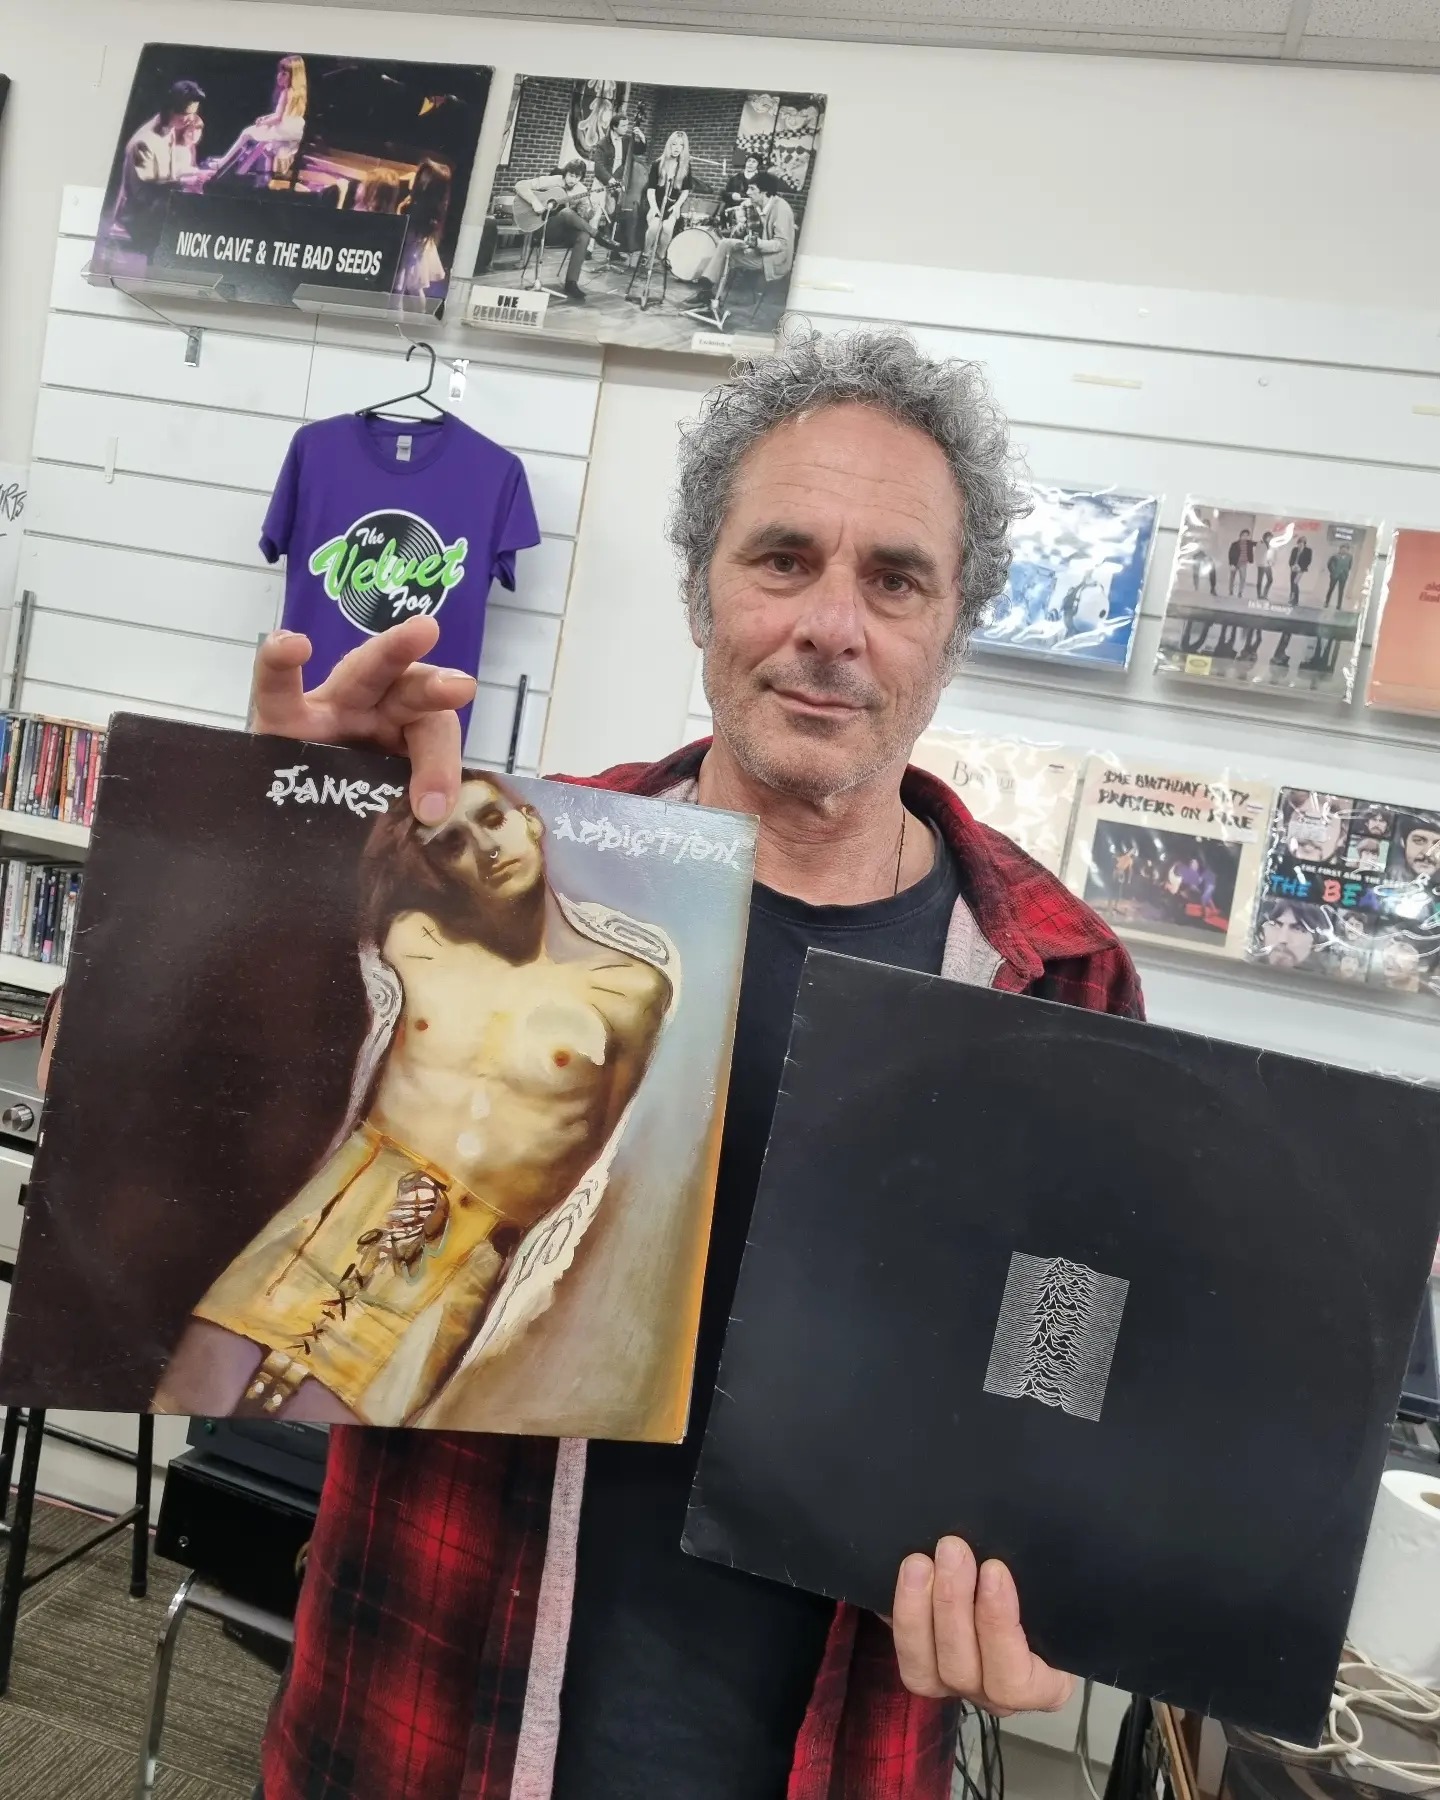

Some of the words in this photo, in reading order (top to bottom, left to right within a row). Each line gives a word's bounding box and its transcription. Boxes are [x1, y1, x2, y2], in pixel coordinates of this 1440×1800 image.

[176, 231, 211, 258] NICK
[213, 235, 253, 263] CAVE
[255, 240, 267, 264] &
[271, 241, 300, 268] THE
[301, 244, 333, 271] BAD
[335, 247, 382, 276] SEEDS
[0, 483, 28, 521] RTS
[355, 527, 385, 547] The
[311, 537, 467, 598] Velvet
[388, 586, 432, 617] Fog
[1098, 788, 1175, 816] PRAYERS
[1181, 806, 1201, 820] ON
[1135, 774, 1203, 797] BIRTHDAY
[1204, 784, 1250, 806] PTY
[266, 765, 404, 818] JANES
[553, 812, 741, 871] ADDICTION
[1270, 875, 1312, 898] THE
